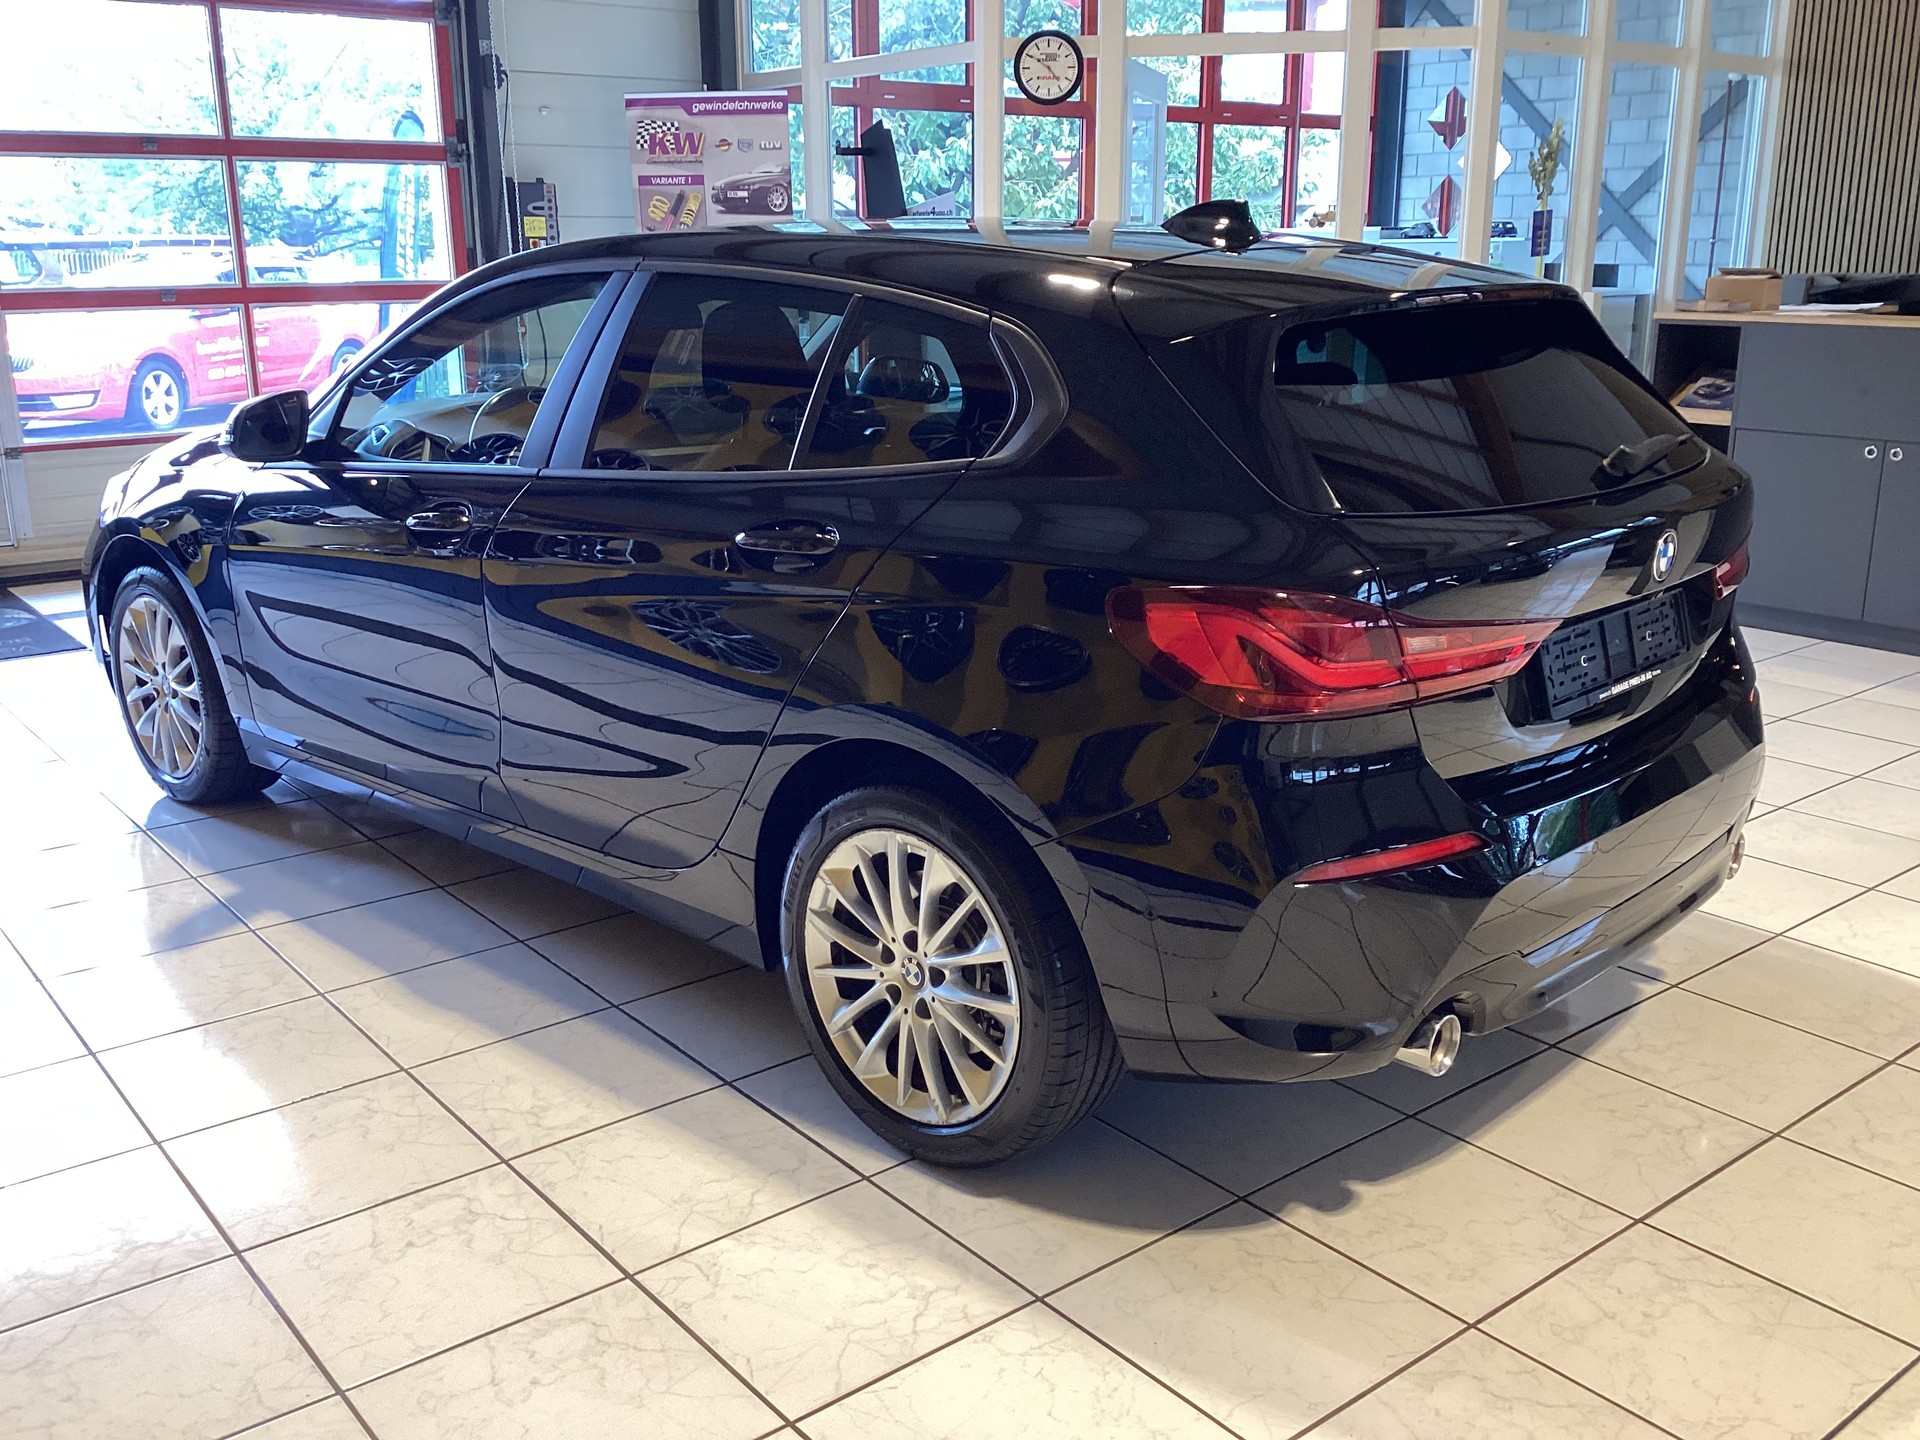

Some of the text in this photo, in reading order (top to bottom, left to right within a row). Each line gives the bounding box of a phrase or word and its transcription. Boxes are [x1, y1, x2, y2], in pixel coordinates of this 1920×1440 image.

[692, 100, 783, 113] gewindefahrwerke
[648, 132, 705, 156] KW
[651, 176, 686, 185] VARIANTE
